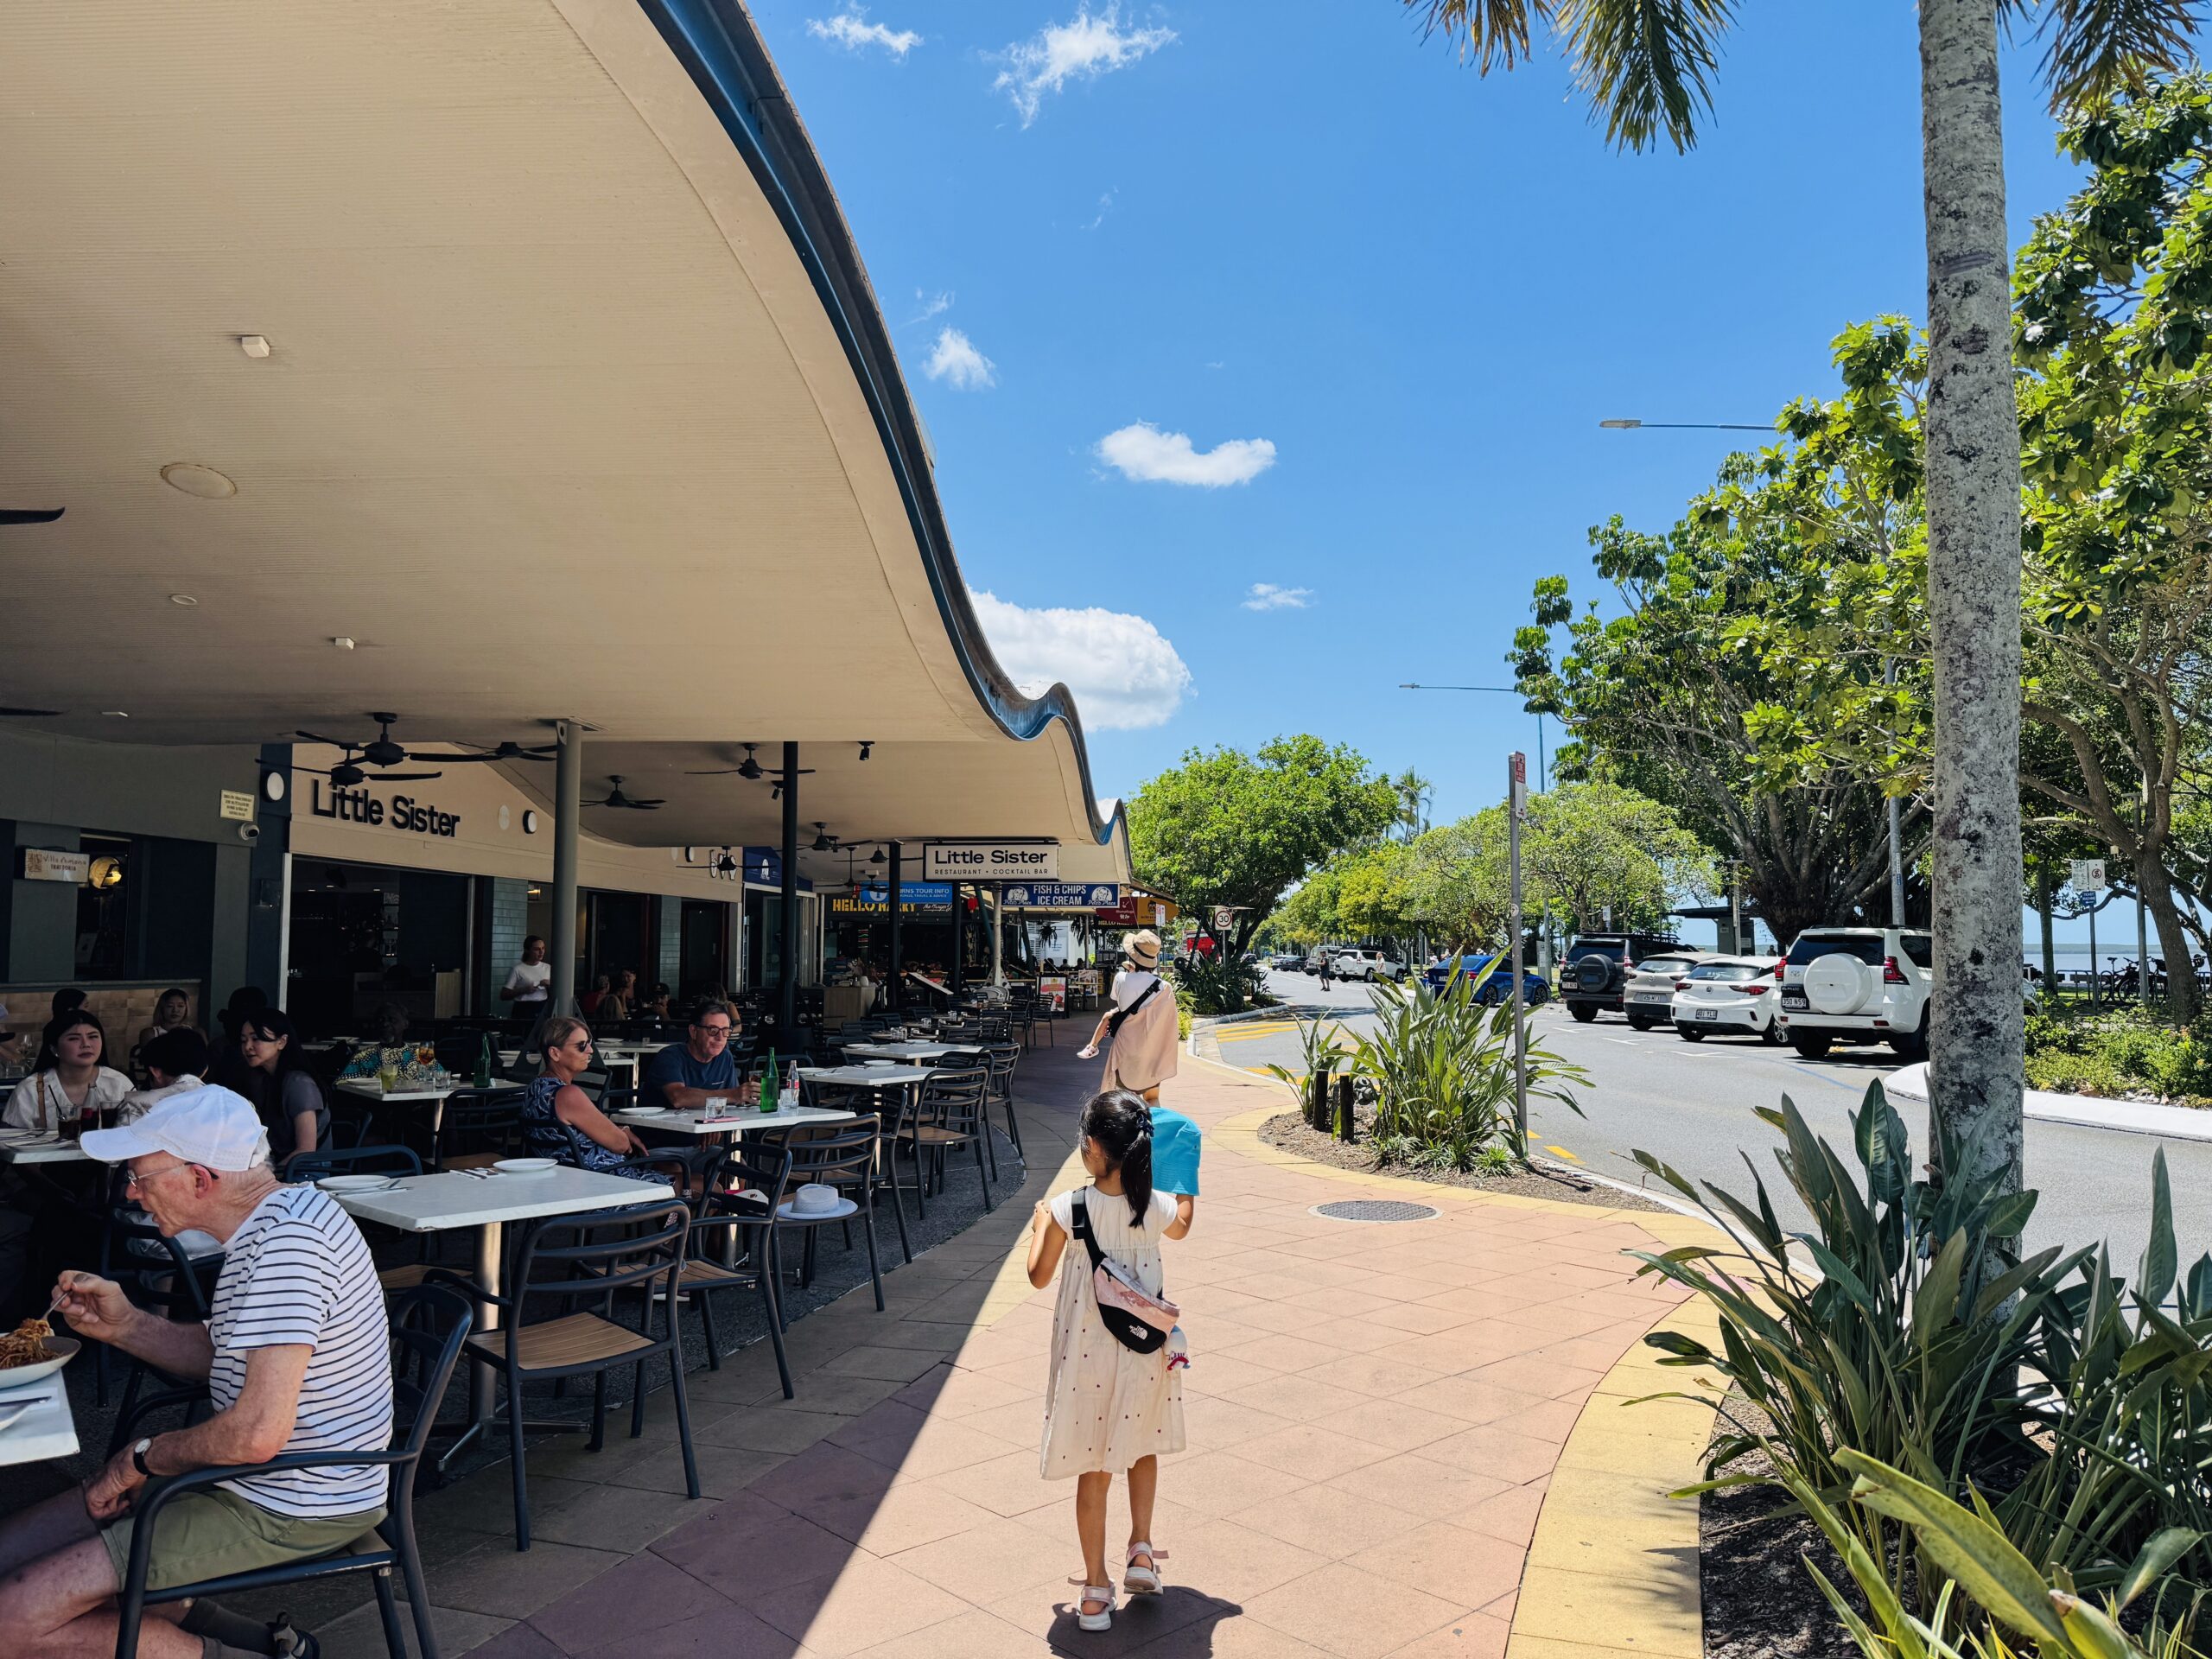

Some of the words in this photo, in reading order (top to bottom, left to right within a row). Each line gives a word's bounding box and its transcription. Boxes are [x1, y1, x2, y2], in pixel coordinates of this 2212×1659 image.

[312, 779, 385, 826] Little
[391, 794, 461, 838] Sister
[935, 849, 984, 864] Little
[990, 849, 1047, 864] Sister
[1033, 885, 1052, 894] FISH
[1054, 885, 1060, 894] &
[1062, 885, 1086, 894] CHIPS
[1037, 896, 1051, 906] ICE
[1052, 896, 1082, 906] CREAM
